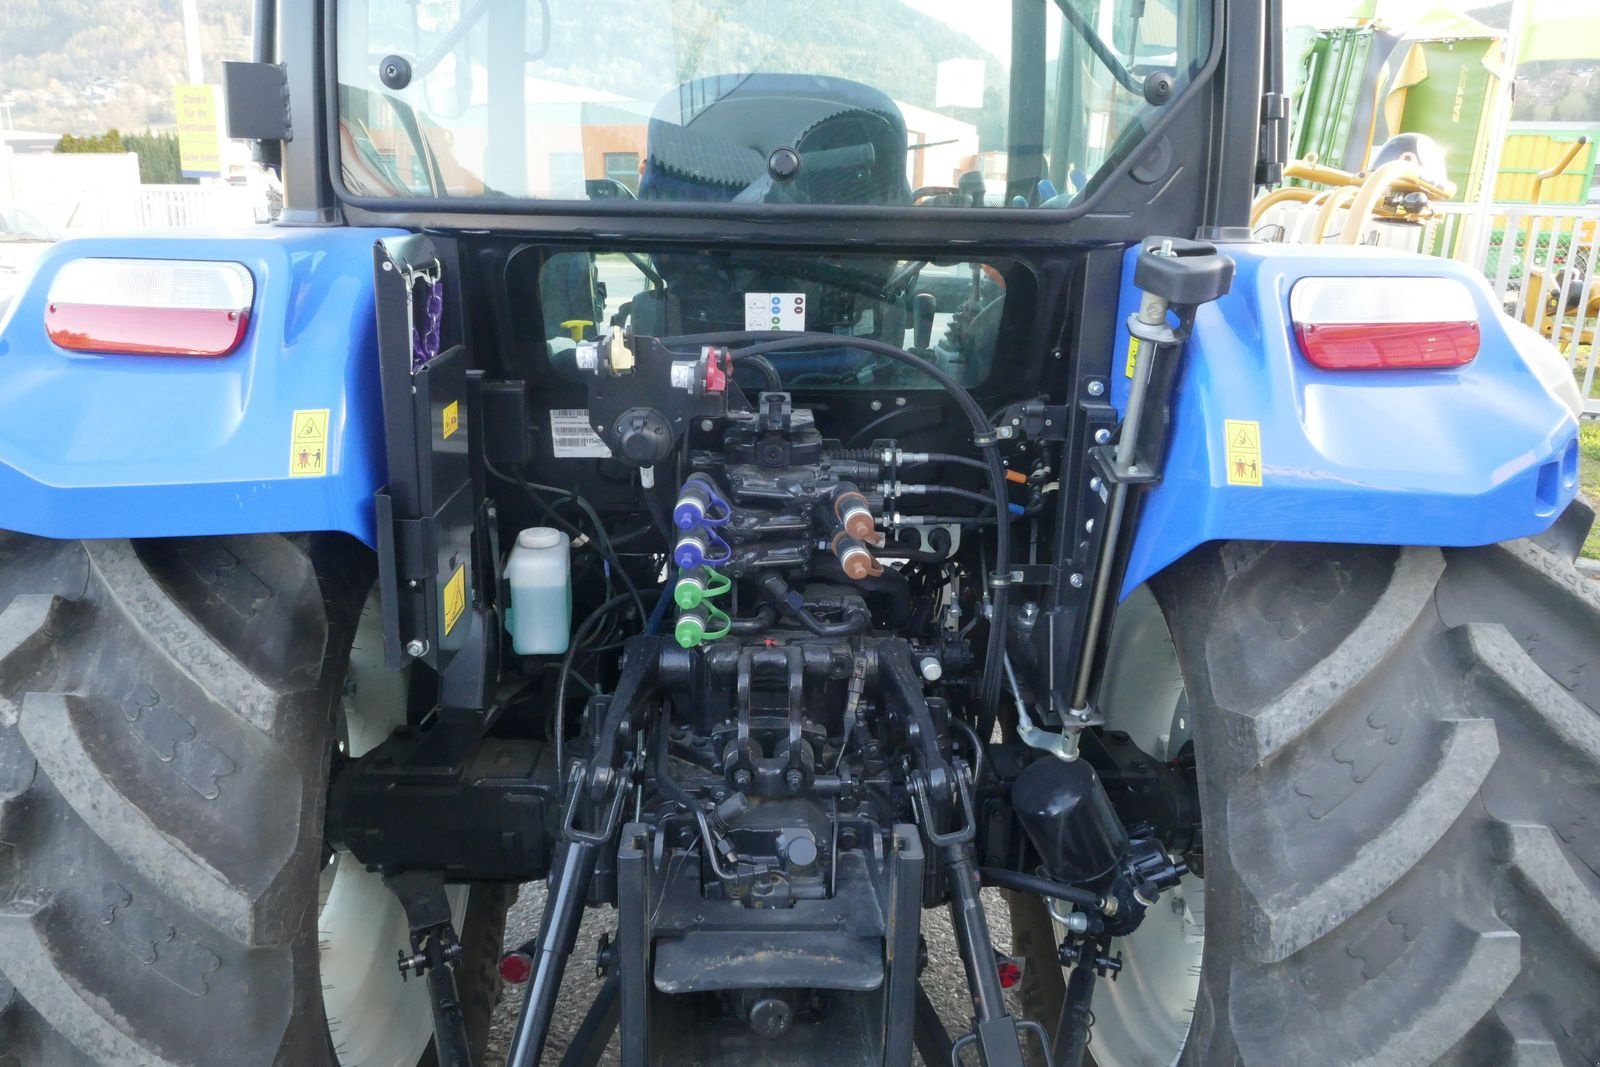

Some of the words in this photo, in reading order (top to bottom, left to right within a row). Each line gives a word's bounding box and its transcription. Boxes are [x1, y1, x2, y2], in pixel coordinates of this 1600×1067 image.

[183, 94, 207, 104] Danke
[179, 122, 217, 132] Vertrauen
[183, 152, 198, 161] Gute
